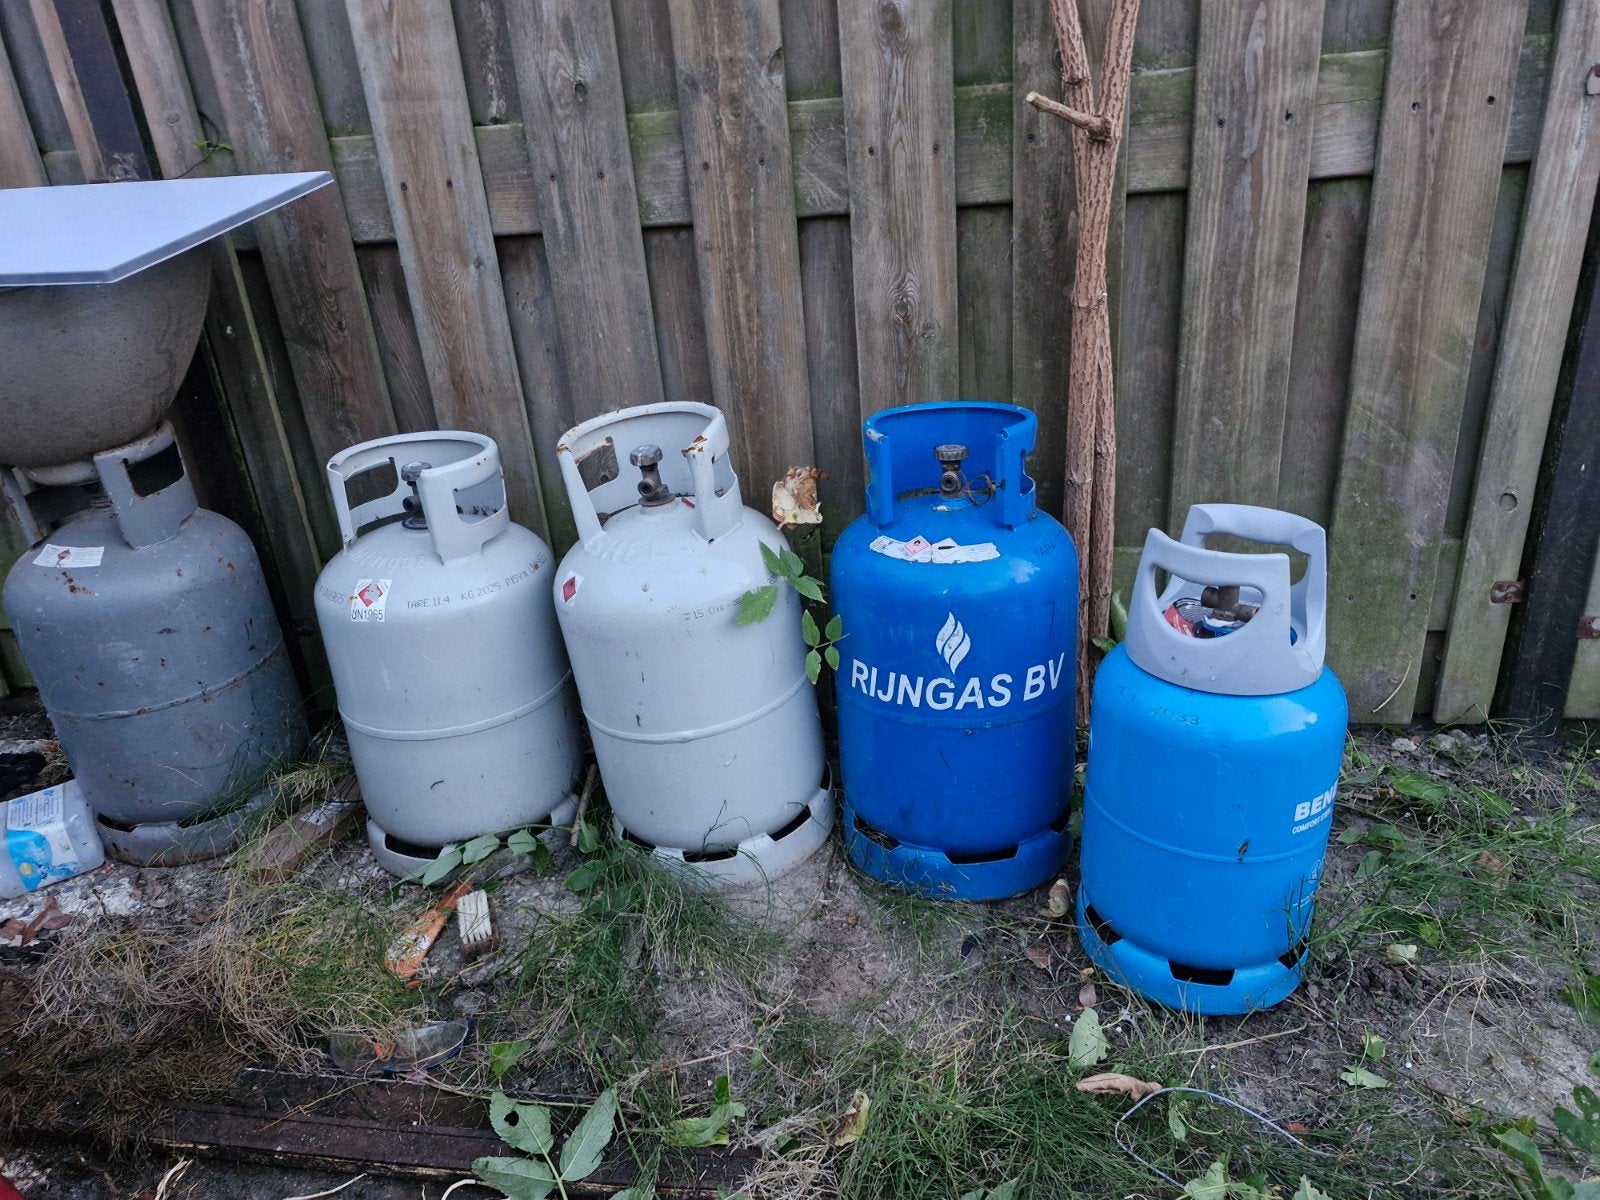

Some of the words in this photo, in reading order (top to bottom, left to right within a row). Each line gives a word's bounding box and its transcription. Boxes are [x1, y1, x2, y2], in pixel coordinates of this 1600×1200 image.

[406, 598, 430, 609] TARE
[460, 590, 475, 601] KG
[476, 581, 502, 597] 2025
[852, 658, 1013, 711] RIJNGAS
[1023, 652, 1065, 702] BV
